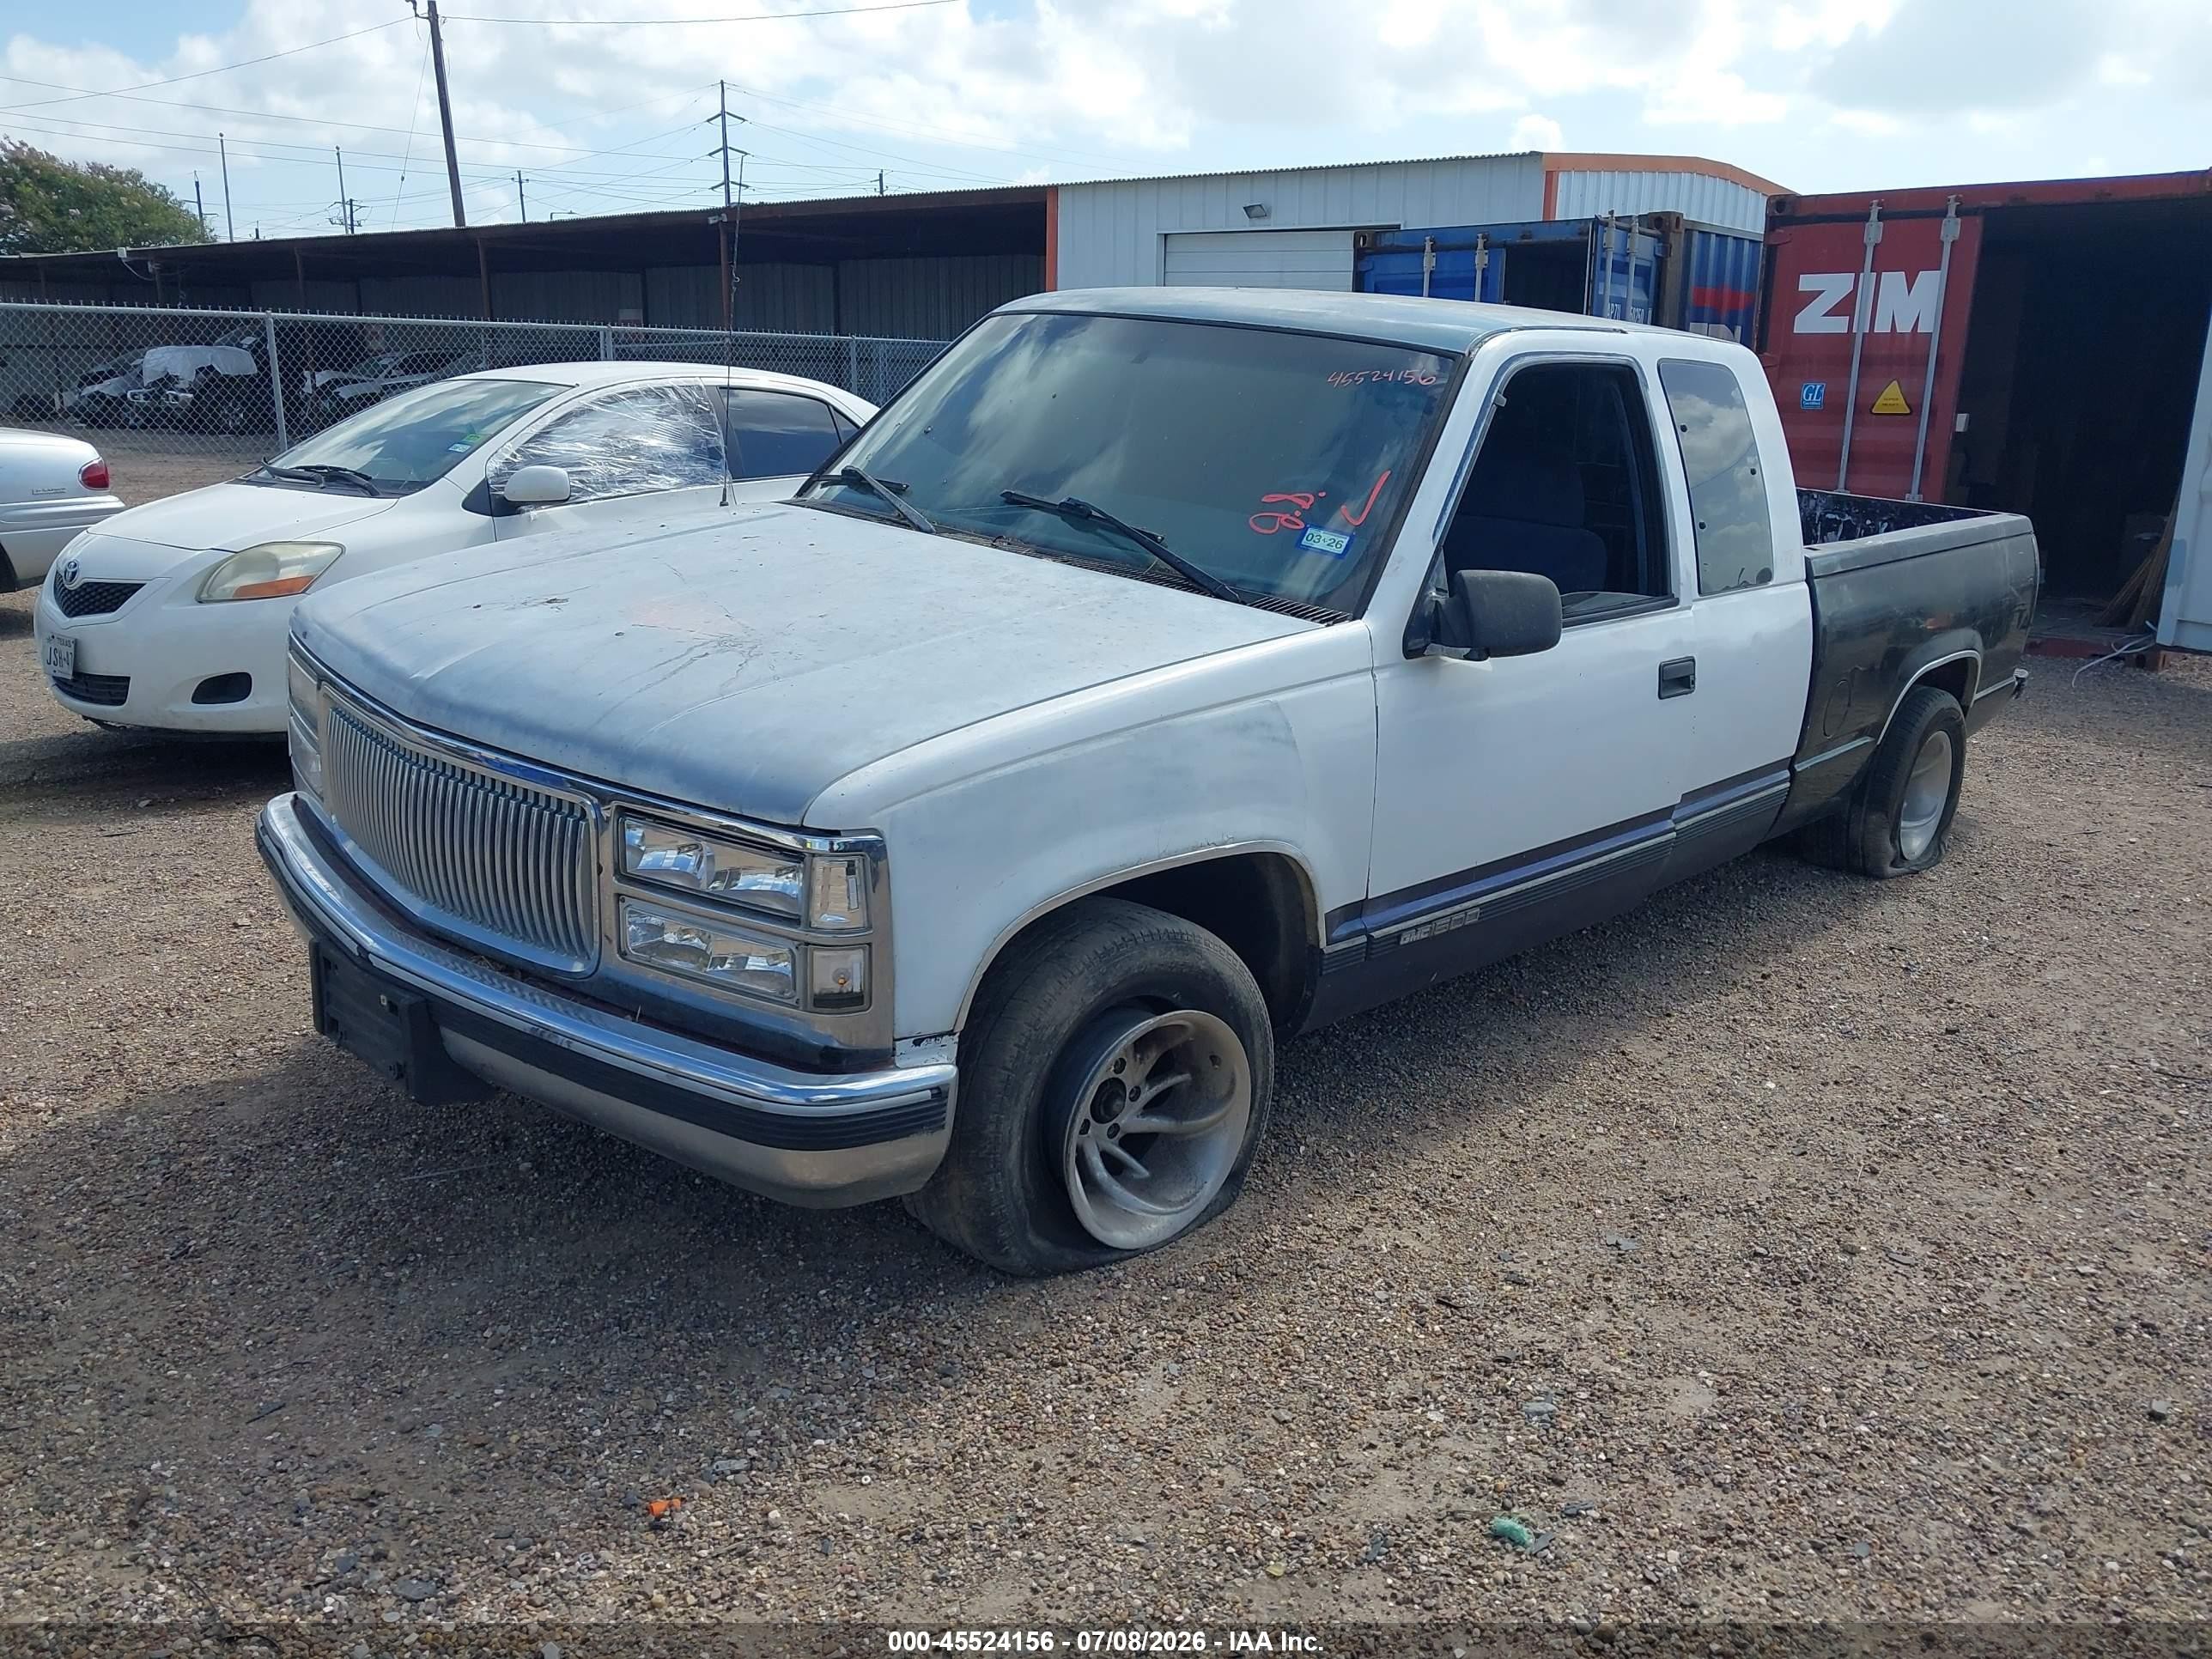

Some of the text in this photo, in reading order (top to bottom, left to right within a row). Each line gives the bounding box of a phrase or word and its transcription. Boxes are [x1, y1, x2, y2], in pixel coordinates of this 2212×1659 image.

[1793, 270, 1942, 333] ZIM
[1328, 369, 1437, 388] 45524156
[1803, 385, 1823, 402] GL
[1305, 532, 1344, 550] 03 26
